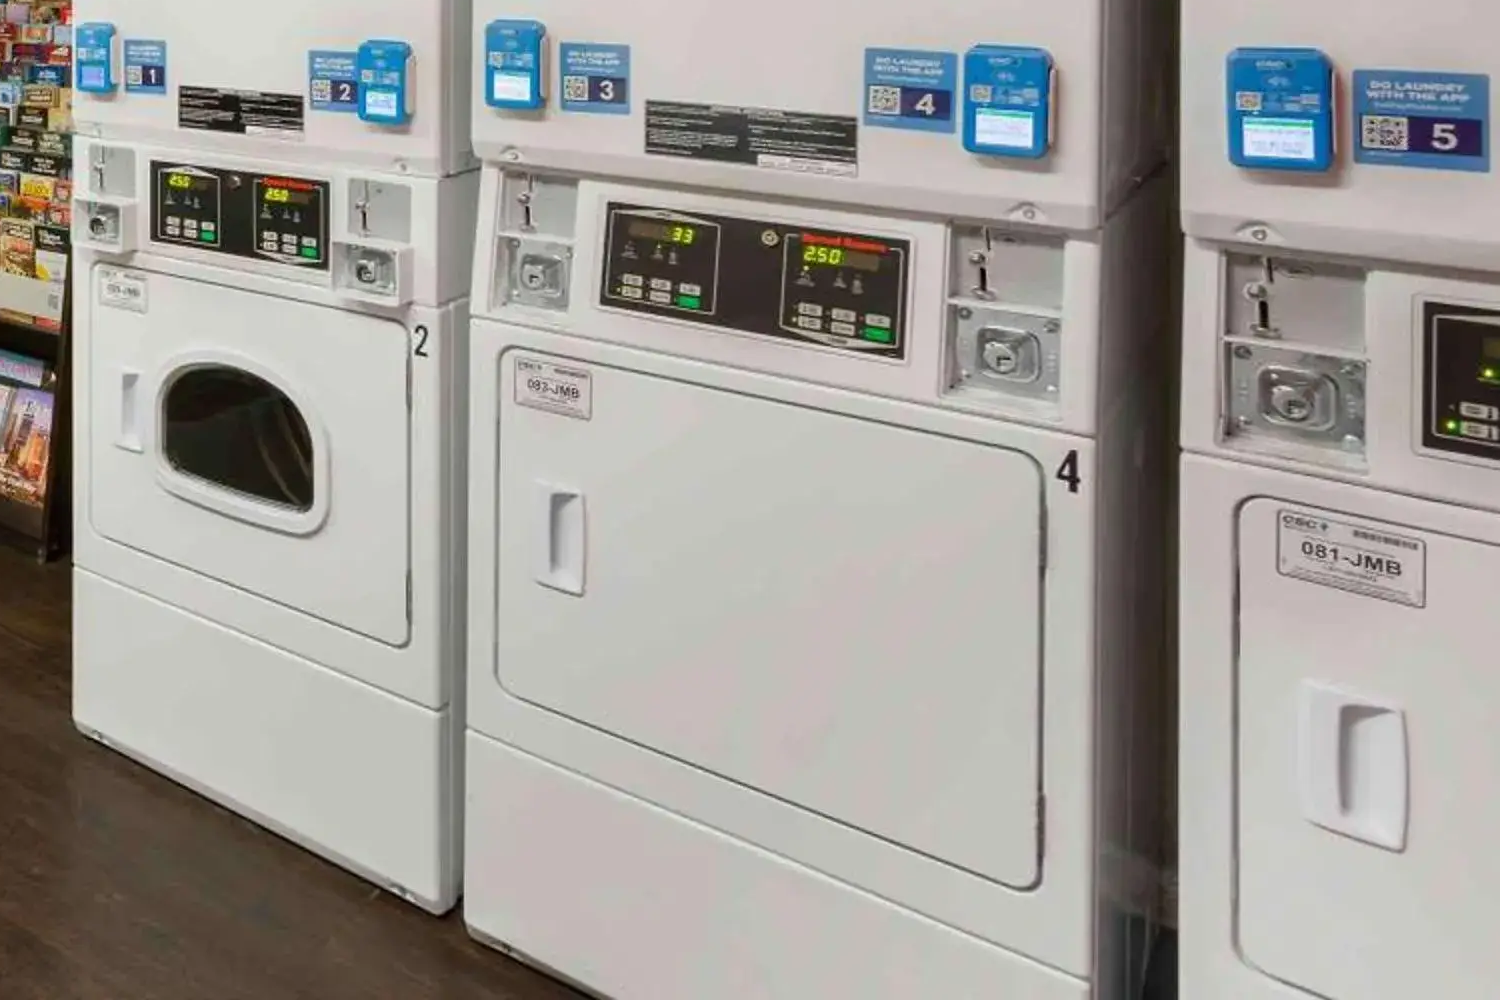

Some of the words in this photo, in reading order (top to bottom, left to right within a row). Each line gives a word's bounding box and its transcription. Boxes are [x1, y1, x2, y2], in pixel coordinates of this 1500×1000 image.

[149, 68, 156, 85] 1
[1394, 81, 1466, 92] LAUNDRY
[339, 83, 352, 101] 2
[599, 79, 615, 101] 3
[1366, 89, 1405, 99] WITH
[1408, 91, 1436, 101] THE
[1439, 92, 1471, 103] APP
[913, 92, 937, 116] 4
[1430, 122, 1460, 152] 5
[671, 226, 695, 245] 33
[413, 324, 429, 358] 2
[1055, 448, 1082, 494] 4
[1300, 540, 1403, 578] 081-JMB
